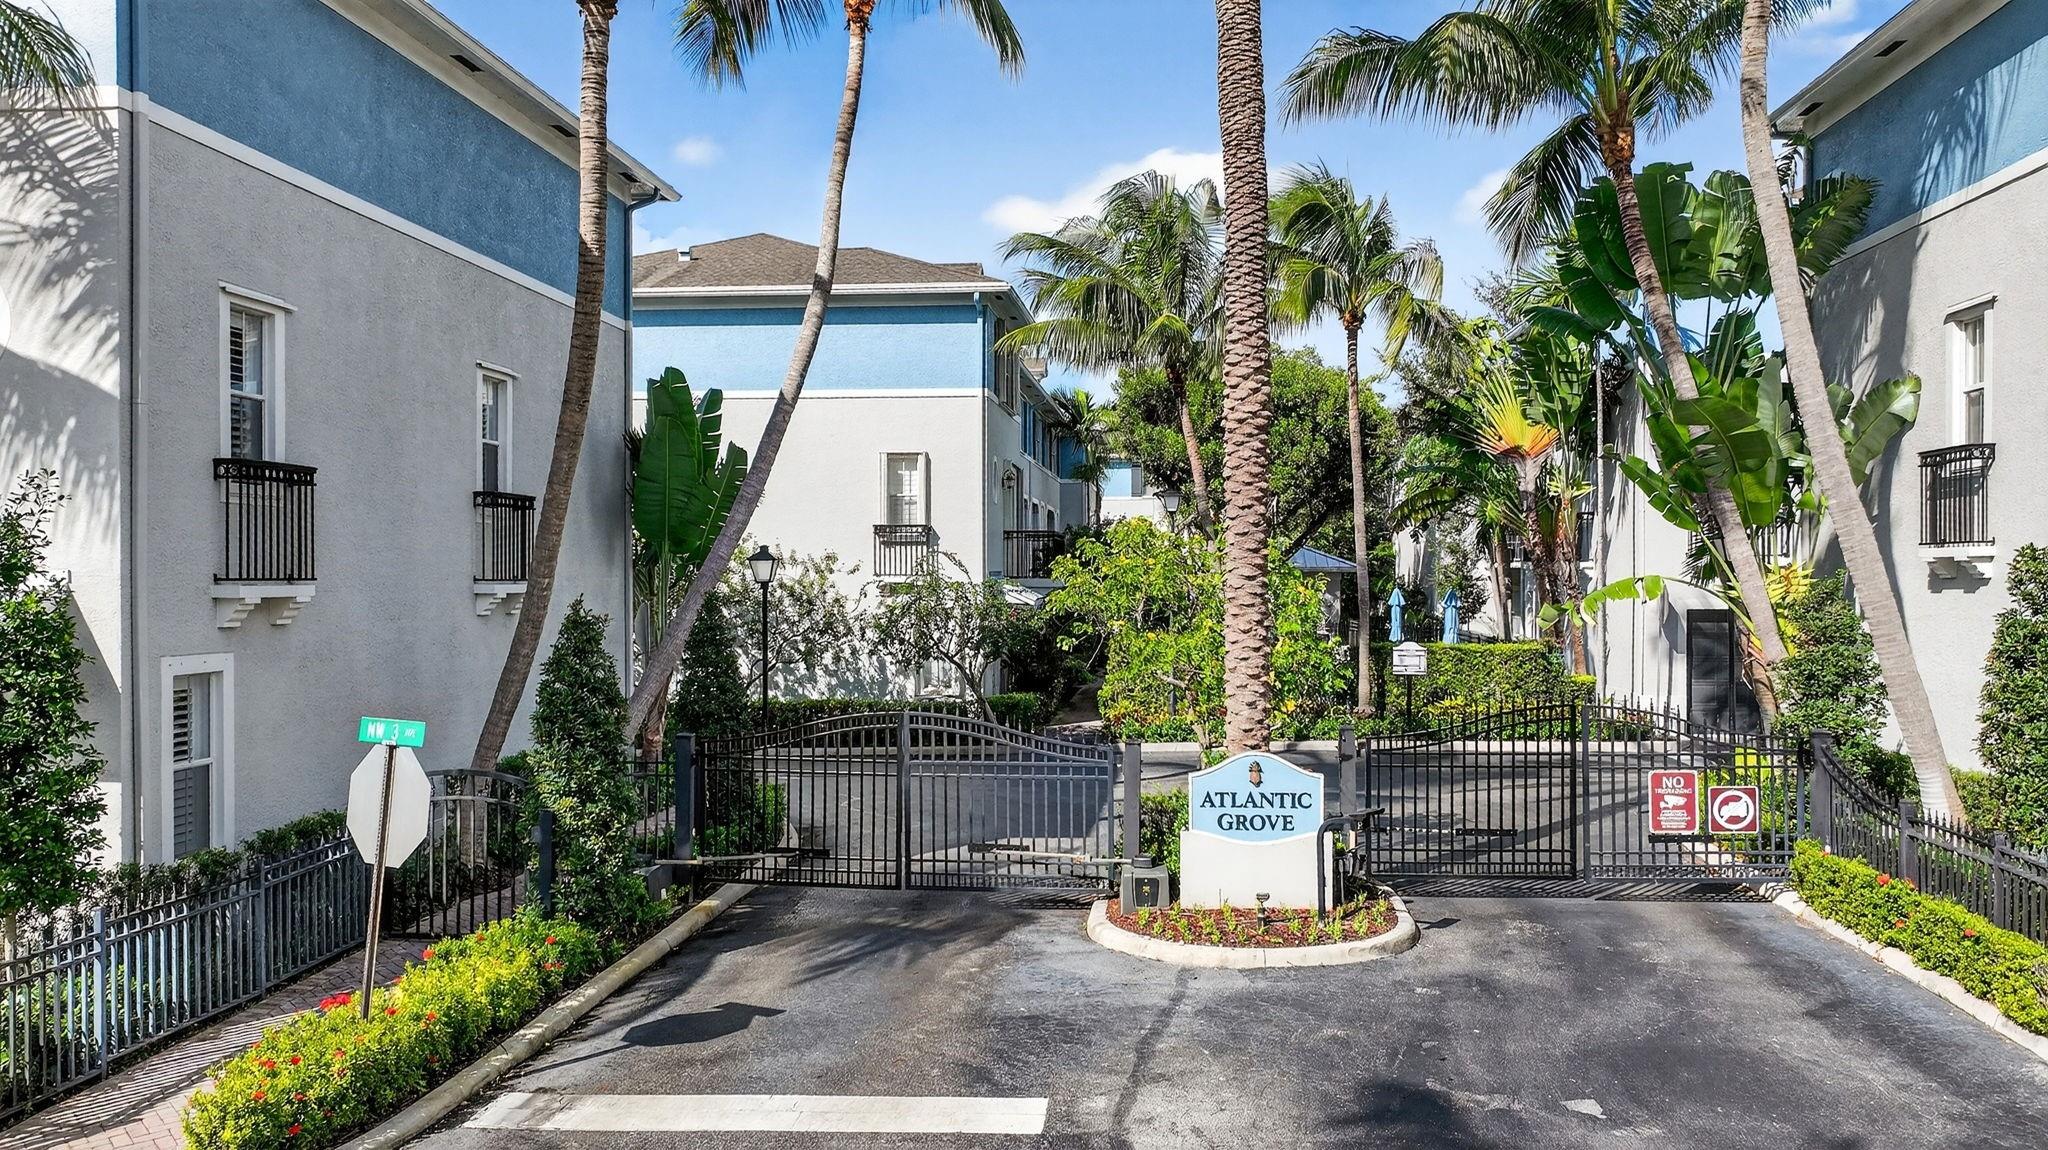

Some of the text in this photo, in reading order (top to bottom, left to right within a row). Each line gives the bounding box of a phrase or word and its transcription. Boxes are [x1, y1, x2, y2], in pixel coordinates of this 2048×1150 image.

[367, 721, 385, 739] NW
[391, 723, 399, 740] 3
[1662, 776, 1685, 788] NO
[1200, 791, 1313, 809] ATLANTIC
[1217, 813, 1295, 831] GROVE
